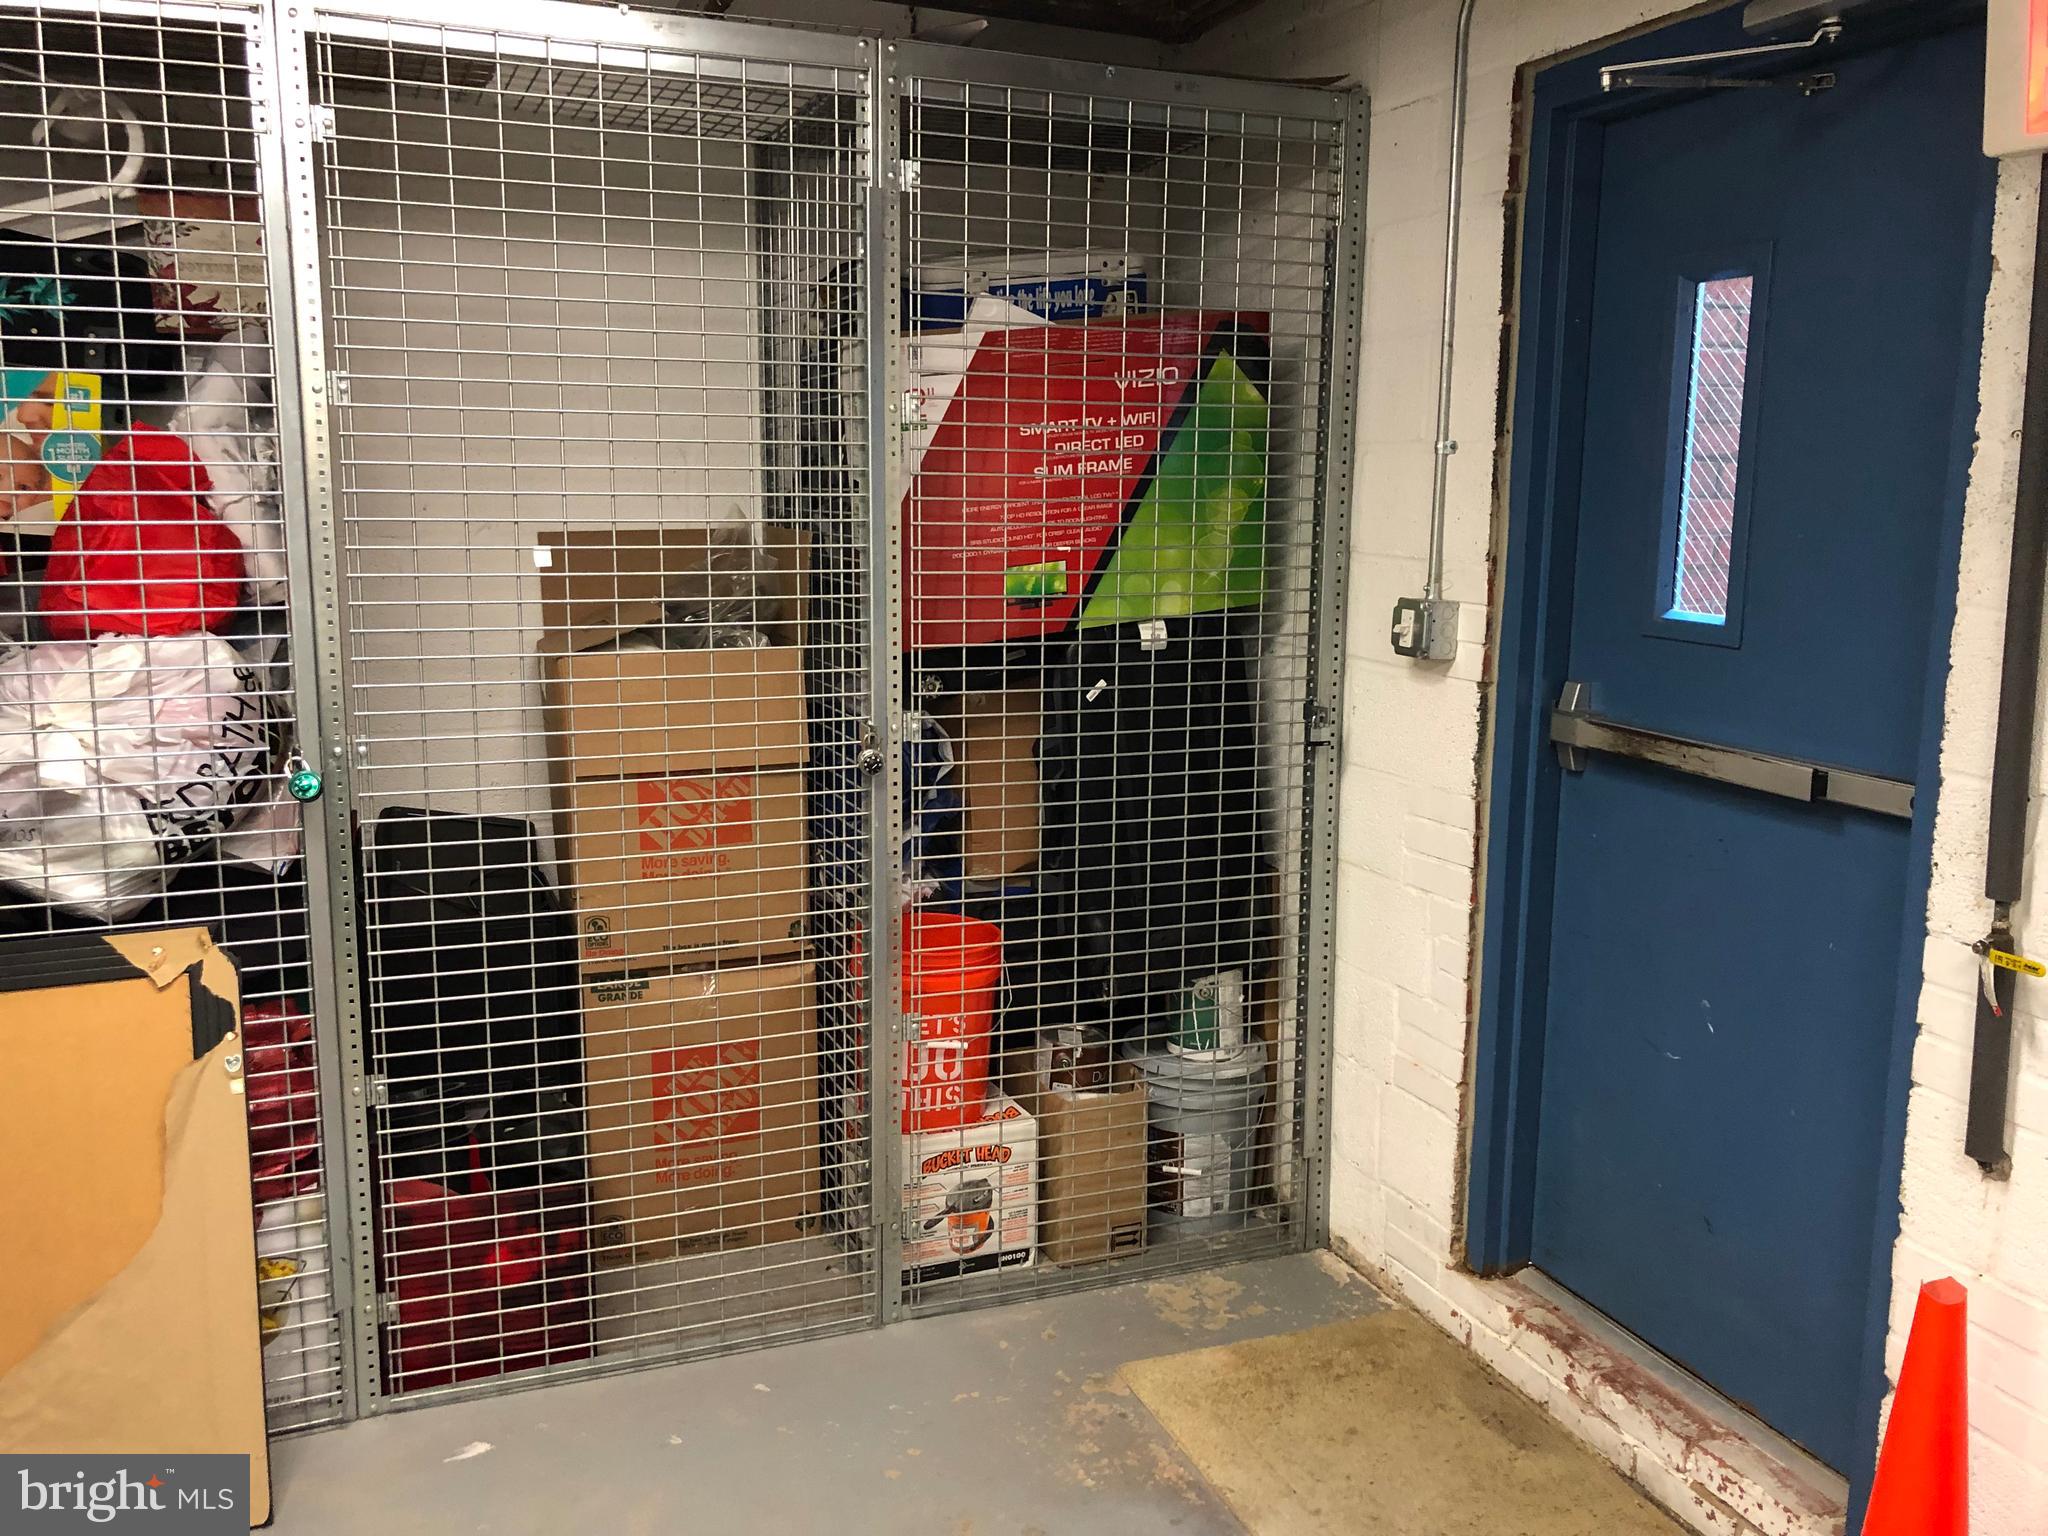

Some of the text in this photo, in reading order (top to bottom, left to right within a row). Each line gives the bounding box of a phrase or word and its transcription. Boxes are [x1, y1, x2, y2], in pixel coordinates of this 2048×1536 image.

[1114, 366, 1179, 389] VIZIO
[1020, 419, 1078, 436] SMART
[1084, 417, 1103, 428] TV
[1123, 411, 1156, 426] WIFI
[1055, 438, 1111, 455] DIRECT
[1115, 434, 1144, 449] LED
[1077, 457, 1133, 474] FRAME
[641, 857, 678, 870] More
[598, 990, 643, 1003] GRANDE
[975, 1144, 1013, 1164] HEAD
[655, 1157, 690, 1170] More
[656, 1170, 690, 1184] More
